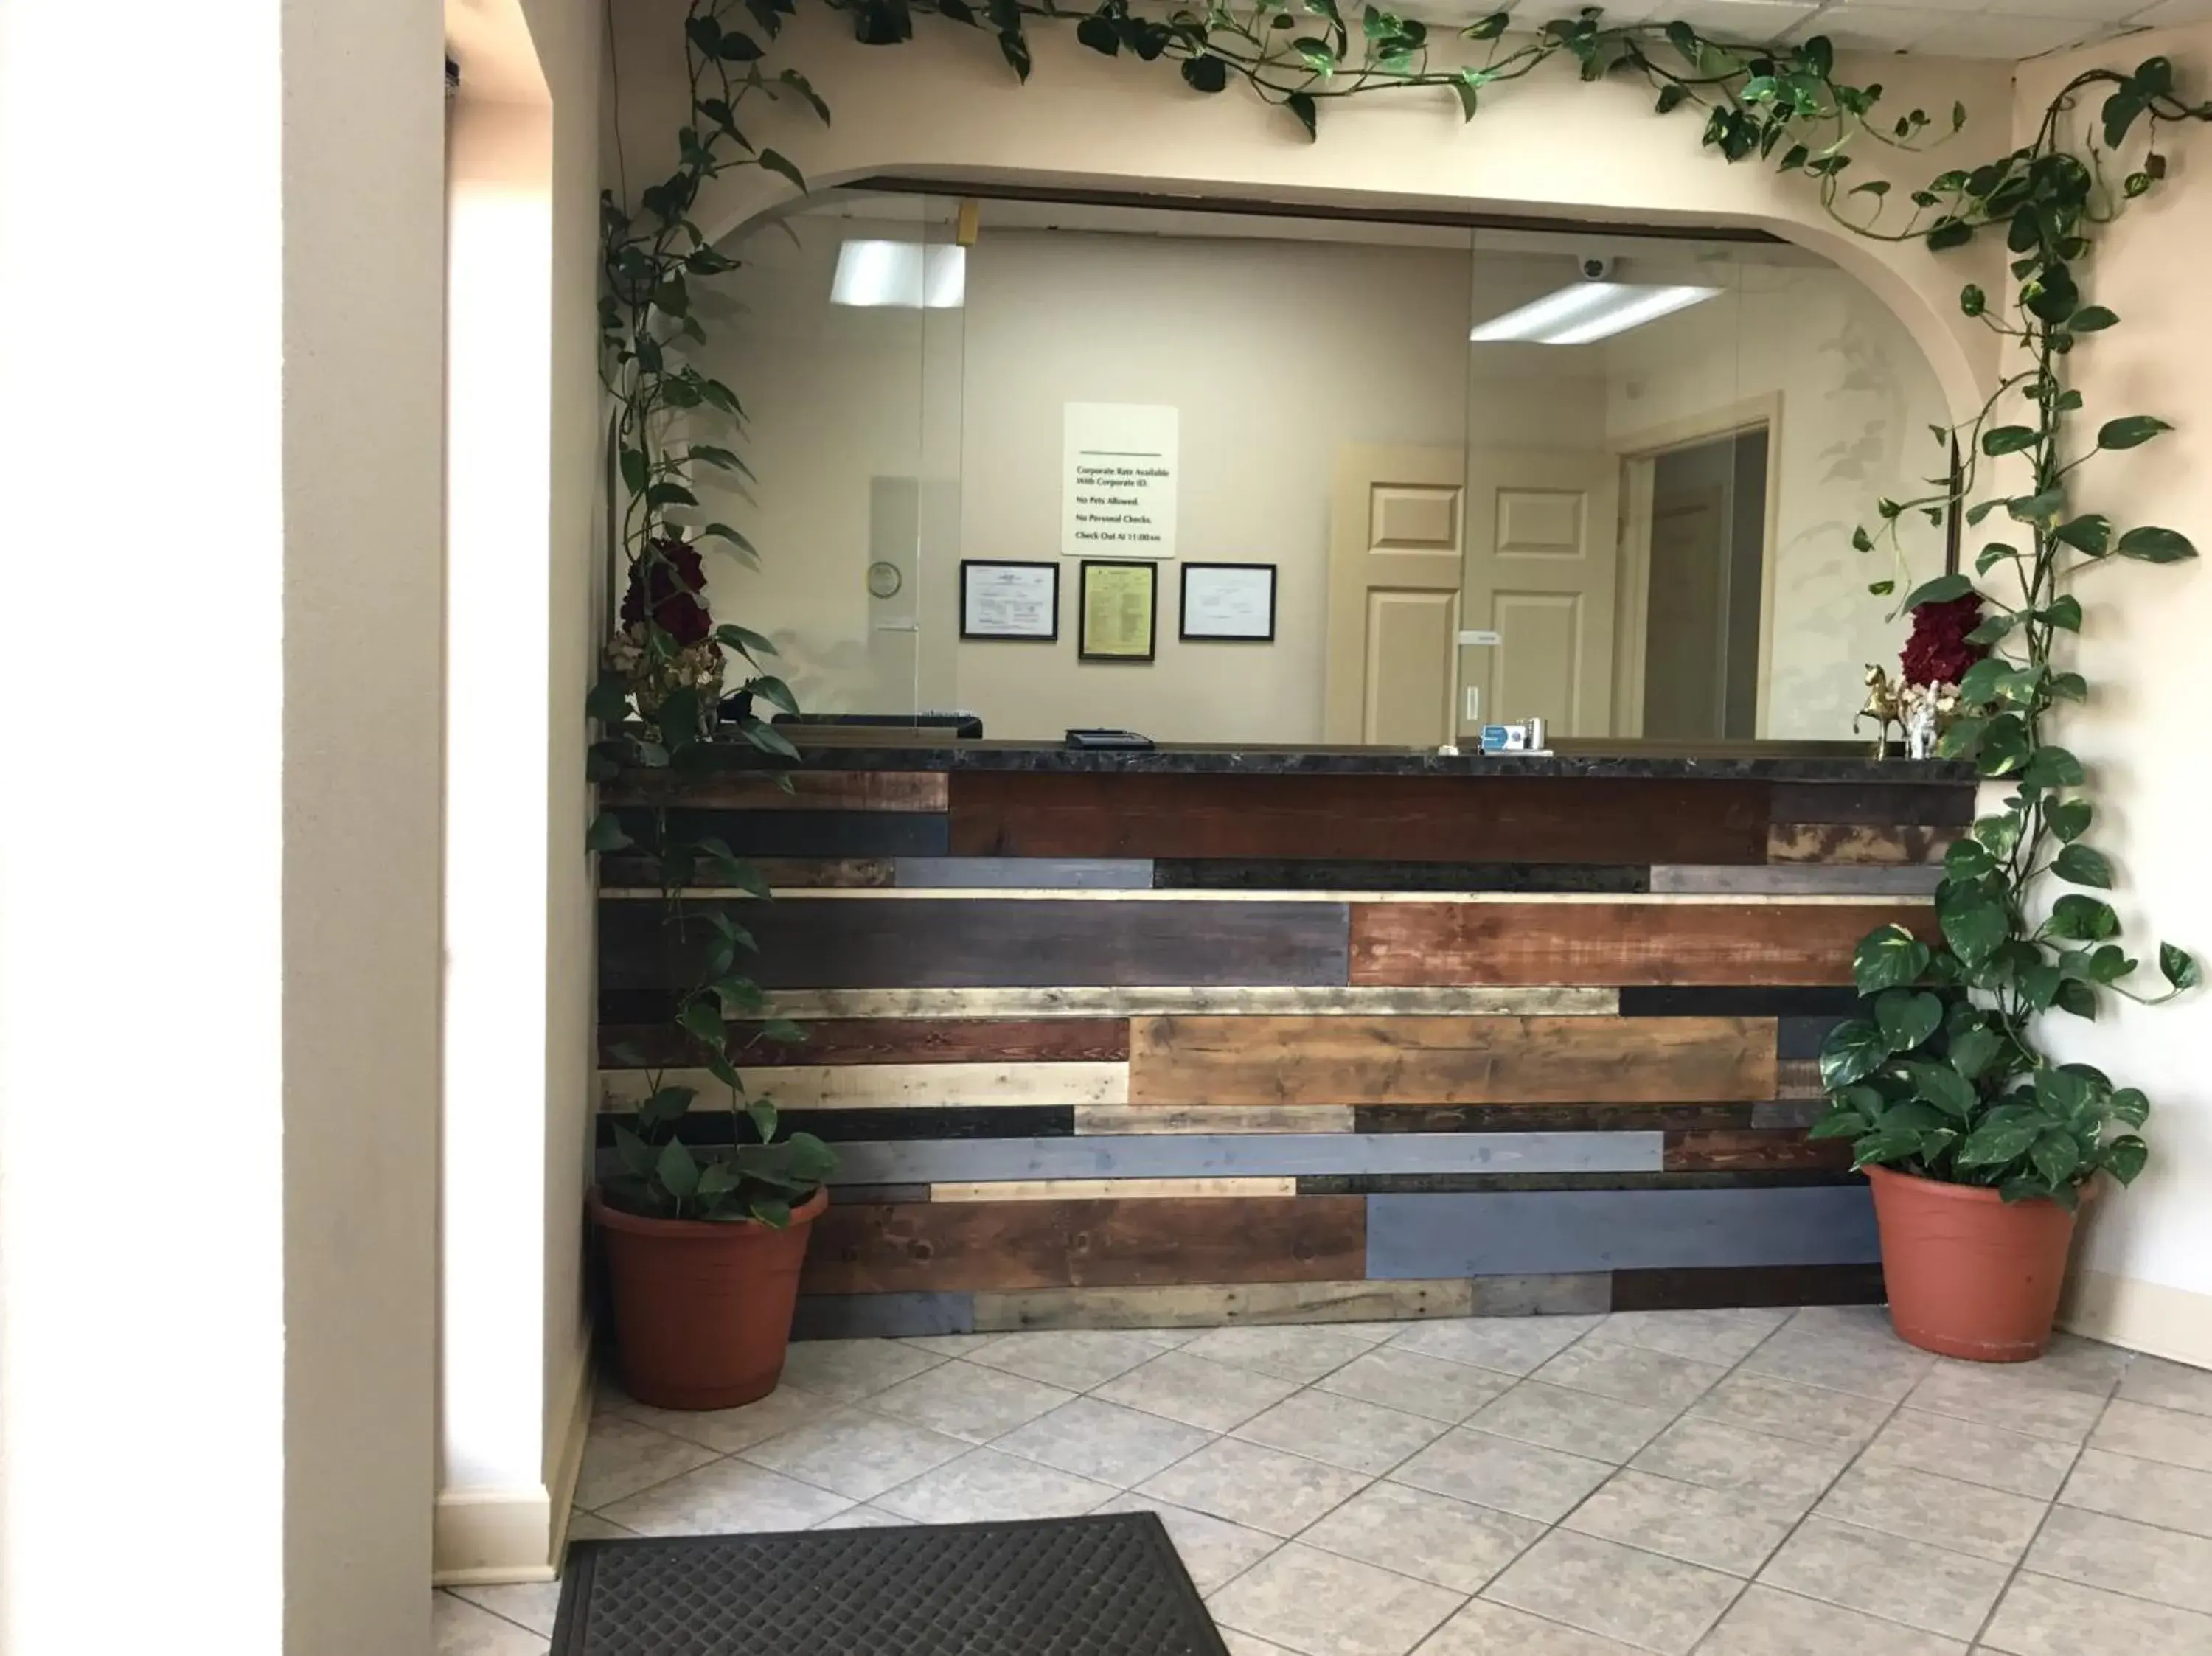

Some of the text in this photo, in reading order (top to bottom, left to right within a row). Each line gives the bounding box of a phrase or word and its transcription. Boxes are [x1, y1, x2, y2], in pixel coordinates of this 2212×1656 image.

[1077, 466, 1170, 477] Corporate Rate Available
[1096, 478, 1135, 487] Corporate
[1090, 496, 1105, 504] Pets
[1089, 514, 1121, 522] Personal
[1075, 531, 1099, 539] Check
[1100, 532, 1116, 540] Out
